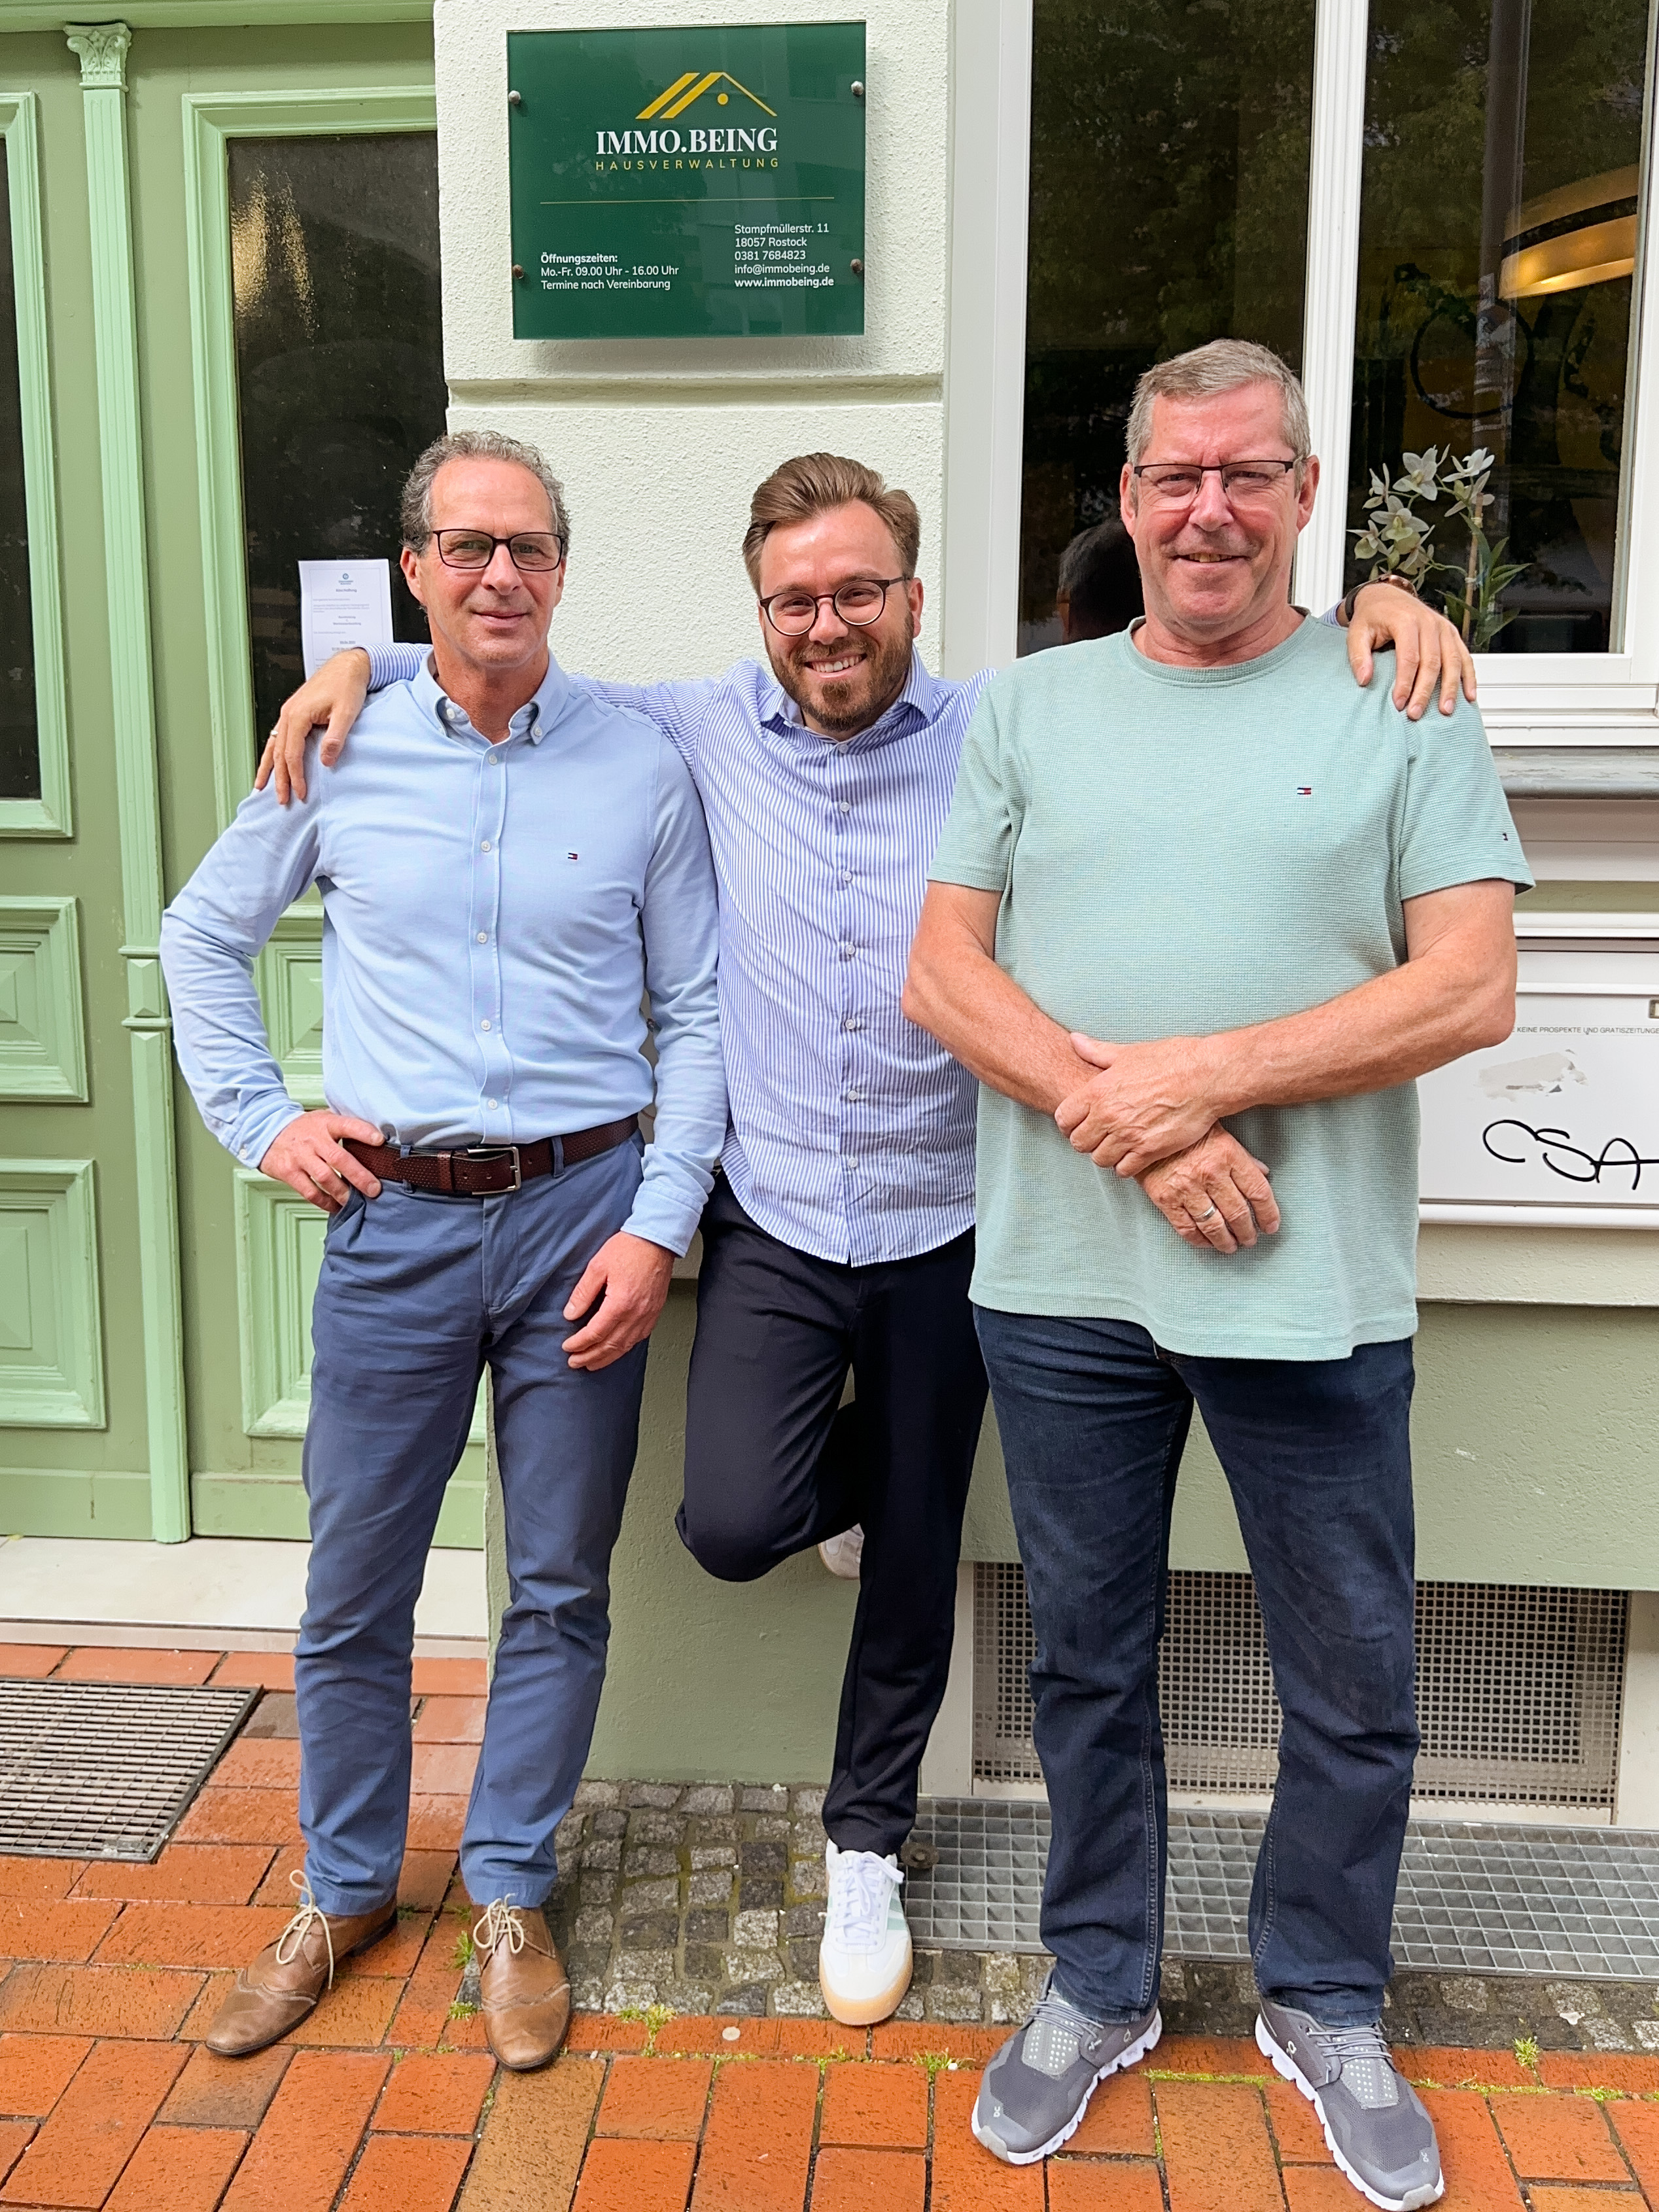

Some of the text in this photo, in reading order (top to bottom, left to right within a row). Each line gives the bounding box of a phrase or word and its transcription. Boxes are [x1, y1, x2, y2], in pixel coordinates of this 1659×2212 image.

[596, 127, 778, 154] IMMO.BEING
[596, 158, 778, 171] HAUSVERWALTUNG
[735, 223, 830, 236] Stampfmüllerstr. 11
[735, 237, 807, 247] 18057 Rostock
[541, 252, 618, 265] Öffnungszeiten:
[734, 250, 806, 260] 0381 7684823
[541, 267, 573, 277] Mo.-Fr.
[575, 266, 602, 276] 09.00
[604, 266, 623, 275] Uhr
[632, 266, 659, 275] 16.00
[661, 265, 680, 275] Uhr
[735, 264, 830, 275] info@immobeing.de
[541, 279, 671, 291] Termine nach Vereinbarung
[735, 277, 834, 289] www.immobeing.de
